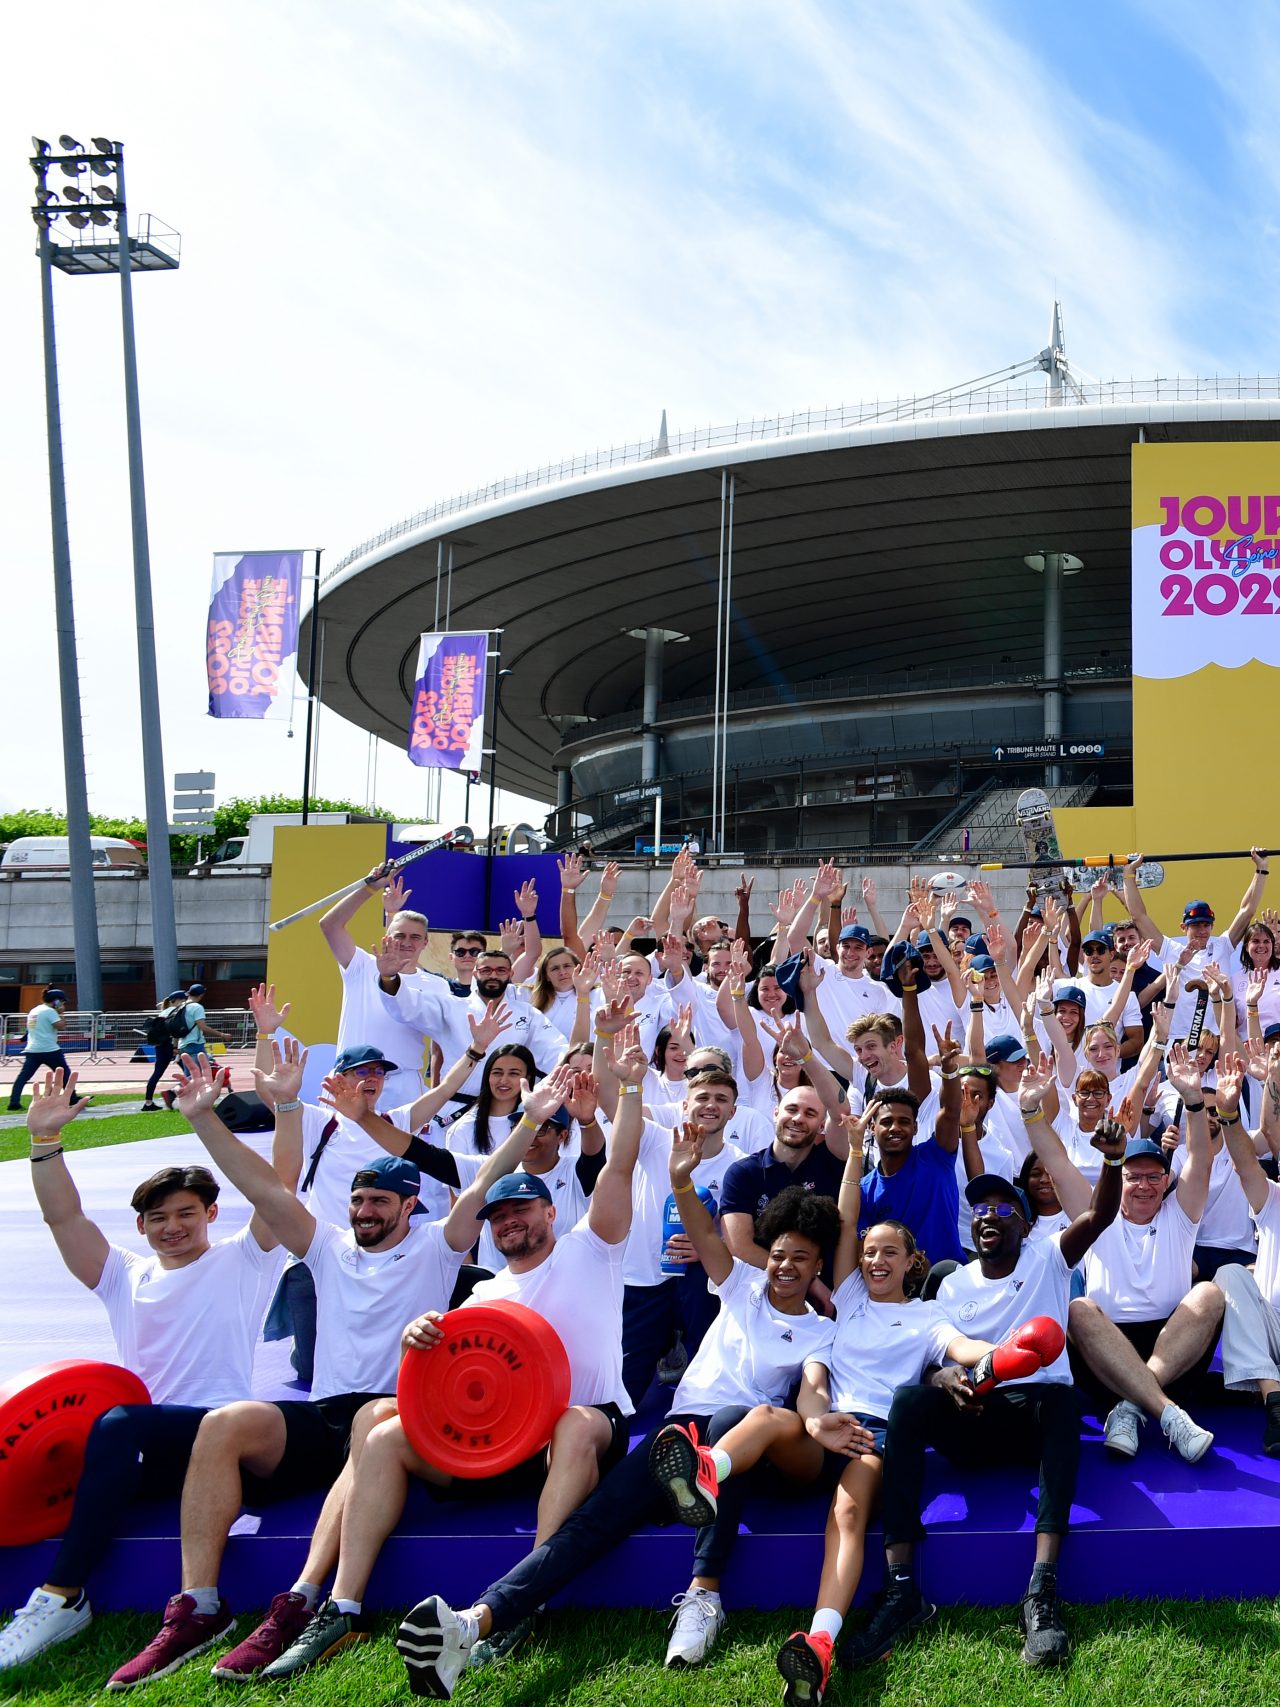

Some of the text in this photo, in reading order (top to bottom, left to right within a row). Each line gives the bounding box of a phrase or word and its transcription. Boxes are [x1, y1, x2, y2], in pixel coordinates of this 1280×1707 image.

[1060, 744, 1067, 756] L
[1189, 1009, 1204, 1046] BURMA
[449, 1336, 522, 1371] PALLINI
